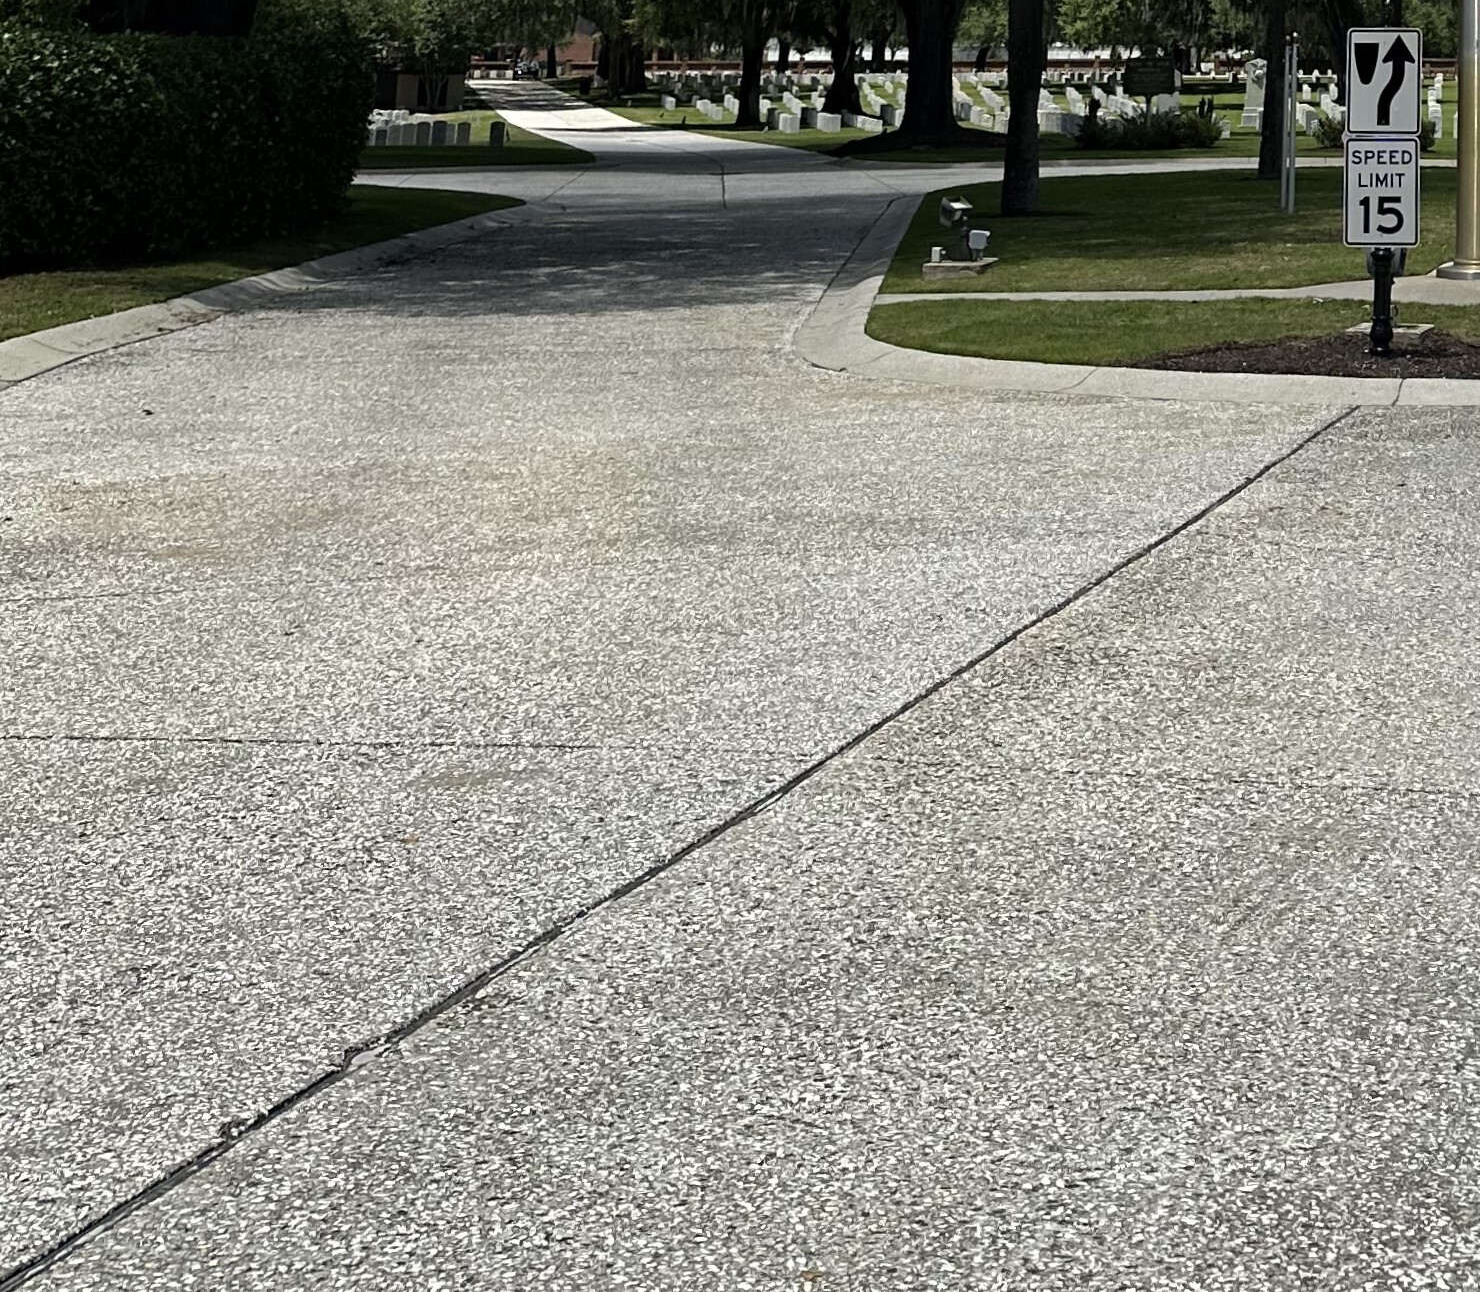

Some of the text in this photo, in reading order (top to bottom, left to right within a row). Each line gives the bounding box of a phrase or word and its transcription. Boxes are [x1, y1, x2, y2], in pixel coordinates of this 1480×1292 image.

[1351, 149, 1412, 165] SPEED
[1358, 172, 1405, 188] LIMIT
[1359, 196, 1405, 235] 15
